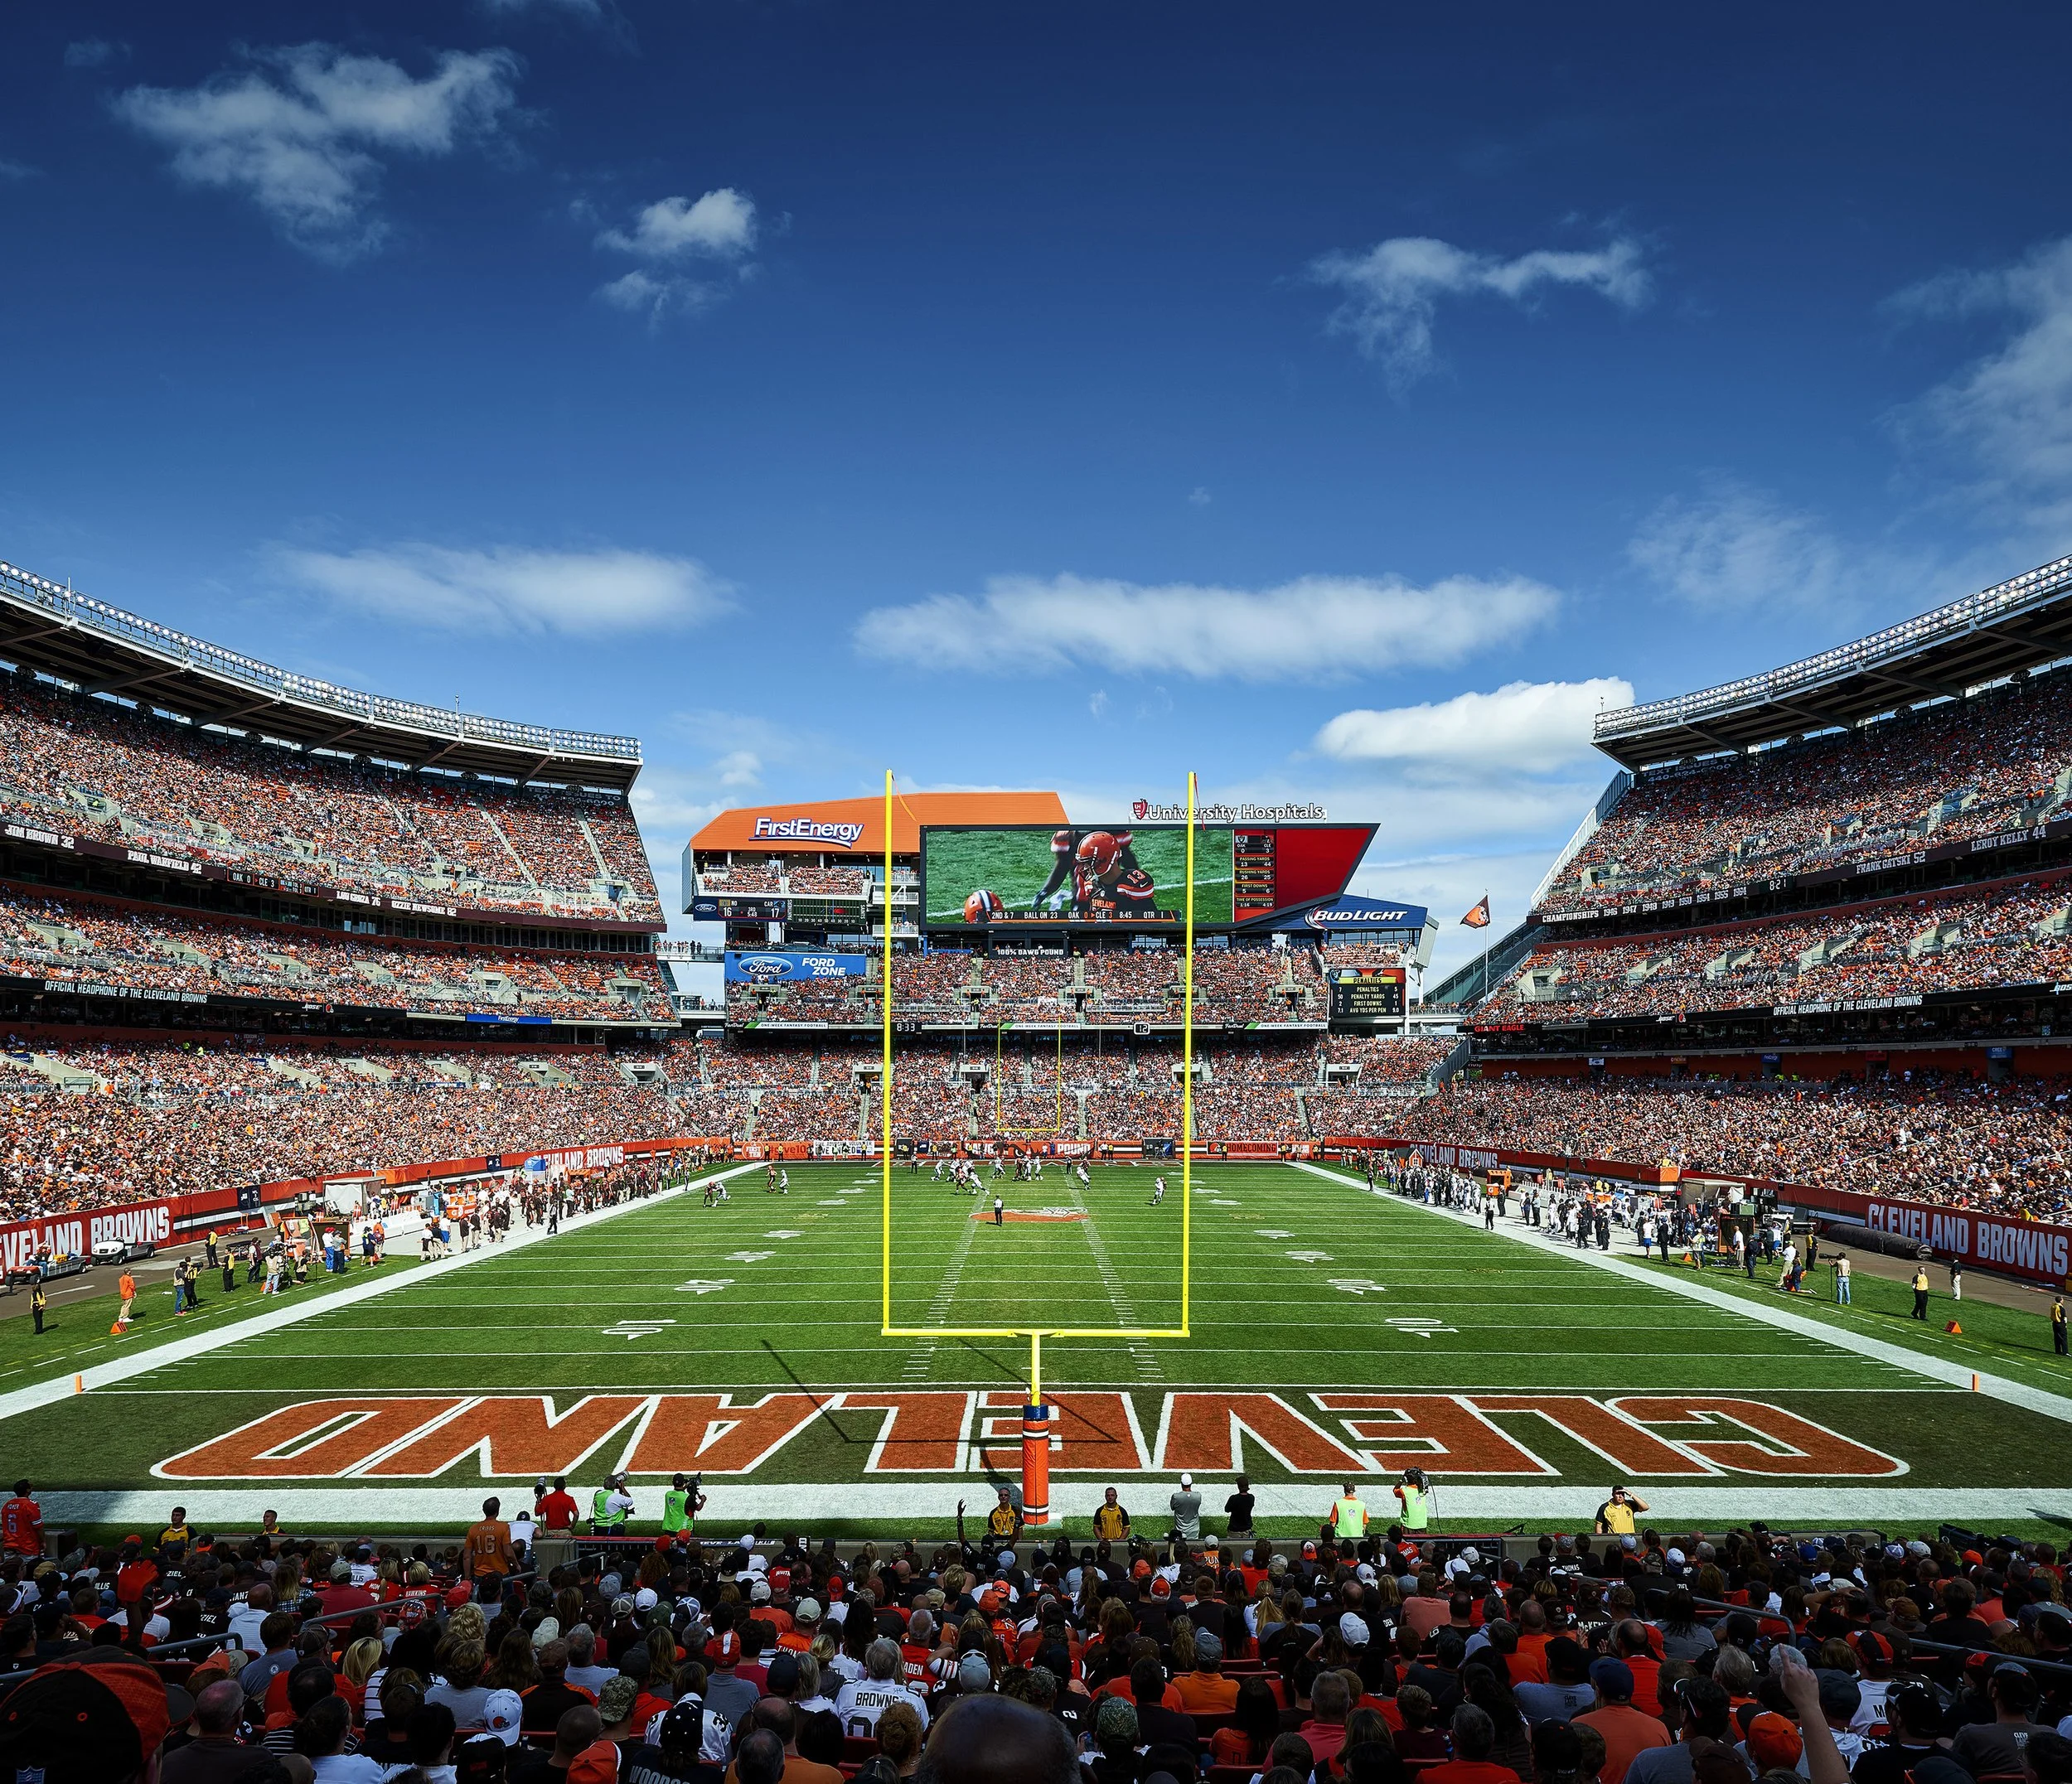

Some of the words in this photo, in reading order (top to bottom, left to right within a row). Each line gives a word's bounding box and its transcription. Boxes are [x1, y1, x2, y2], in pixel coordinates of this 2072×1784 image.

[1148, 804, 1237, 823] University
[1242, 803, 1324, 823] Hospitals
[4, 824, 25, 839] JIM
[26, 828, 59, 845] BROWN
[61, 834, 75, 849] 32
[755, 817, 864, 843] FirstEnergy
[1971, 836, 1998, 852] LEROY
[1999, 829, 2029, 846] KELLY
[2031, 824, 2046, 839] 44
[128, 849, 149, 863] PAUL
[149, 854, 190, 872] WARFIELD
[190, 862, 202, 874] 42
[1856, 859, 1881, 874] FRANK
[1881, 854, 1910, 869] GATSKI
[1913, 851, 1926, 864] 52
[232, 872, 243, 882] OAK
[246, 875, 250, 883] 0
[259, 877, 268, 887] CLE
[270, 879, 275, 887] 3
[1127, 869, 1146, 884] 13
[336, 890, 350, 901] LOU
[371, 896, 381, 907] 76
[412, 902, 446, 915] NEWSOME
[724, 907, 733, 917] 16
[771, 908, 780, 918] 17
[1314, 910, 1353, 921] BUD
[1353, 910, 1408, 921] LIGHT
[1542, 910, 1599, 923] CHAMPIONSHIPS
[1603, 907, 1618, 916] 1946
[1622, 905, 1637, 914] 1947
[748, 959, 783, 974] Ford
[801, 957, 836, 967] FORD
[811, 966, 846, 976] ZONE
[45, 980, 75, 993] OFFICIAL
[77, 984, 118, 997] HEADPHONE
[119, 987, 128, 997] OF
[129, 988, 143, 998] THE
[143, 989, 180, 1002] CLEVELAND
[181, 993, 207, 1003] BROWNS
[1773, 1006, 1797, 1016] OFFICIAL
[1798, 1002, 1832, 1014] HEADPHONE
[1833, 1001, 1842, 1012] OF
[1842, 1000, 1855, 1011] THE
[1856, 997, 1892, 1010] CLEVELAND
[1893, 994, 1923, 1008] BROWNS
[897, 1023, 915, 1032] 8:33
[1138, 1024, 1149, 1033] 12
[1502, 1023, 1525, 1032] EAGLE
[587, 1145, 623, 1168] BROWNS
[1057, 1143, 1091, 1155] POUND
[1227, 1143, 1276, 1153] HOMECOMING
[1459, 1148, 1498, 1169] BROWNS
[0, 1221, 83, 1279] VELAND
[90, 1206, 170, 1245] BROWNS
[1868, 1203, 1969, 1255] CLEVELAND
[1977, 1221, 2069, 1276] BROWNS
[150, 1390, 1910, 1479] CLEVELAND
[7, 1513, 17, 1533] 6
[475, 1535, 497, 1554] 16
[405, 1589, 427, 1598] HAWKINS
